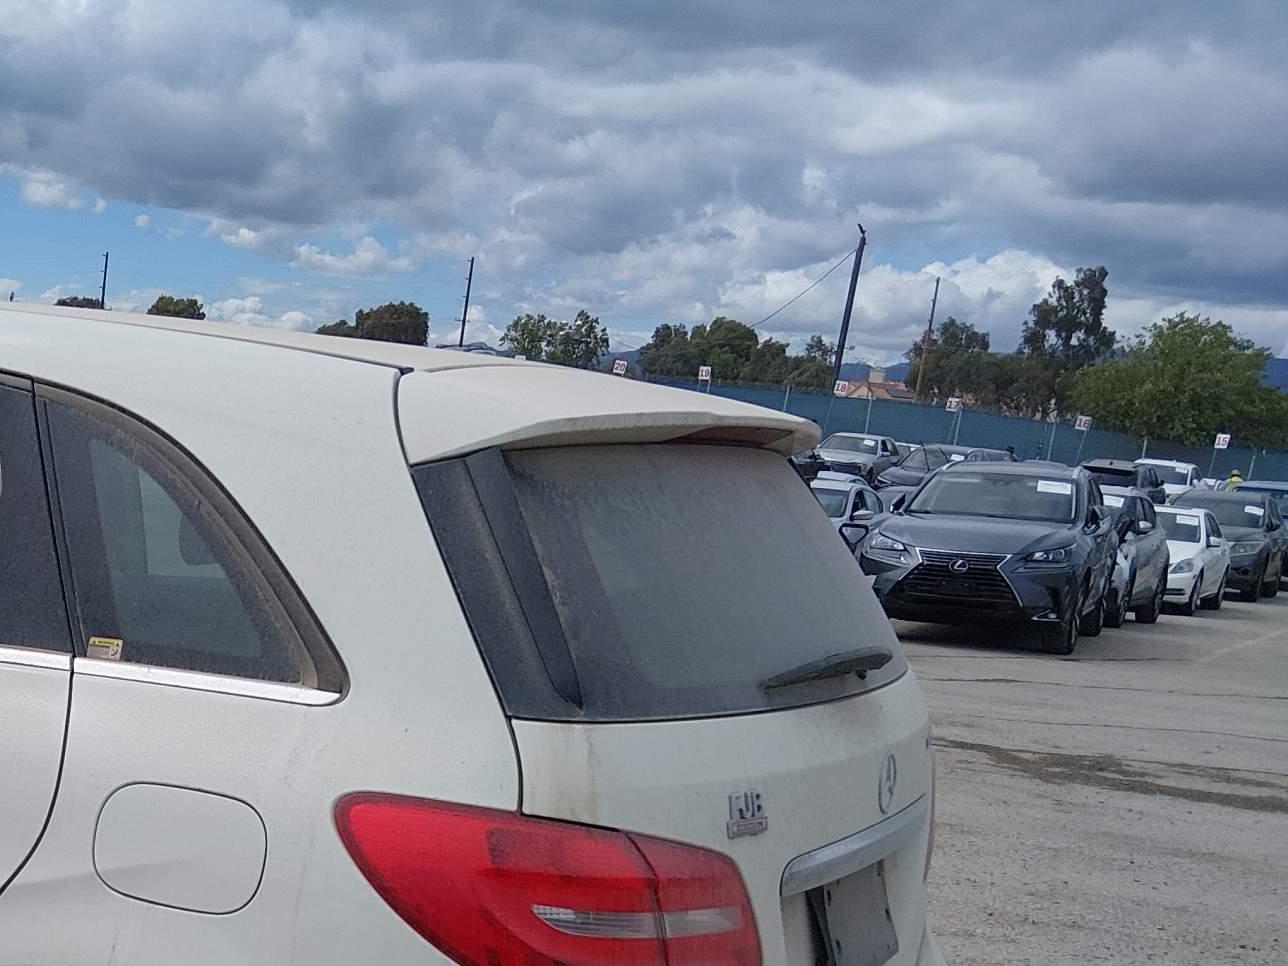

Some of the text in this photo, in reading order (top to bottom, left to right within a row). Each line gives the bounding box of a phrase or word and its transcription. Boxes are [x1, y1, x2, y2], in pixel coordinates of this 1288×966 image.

[614, 362, 626, 372] 20
[699, 368, 710, 378] 19
[835, 383, 847, 393] 18
[947, 400, 960, 410] 17
[1077, 418, 1090, 429] 16
[1216, 436, 1228, 446] 15
